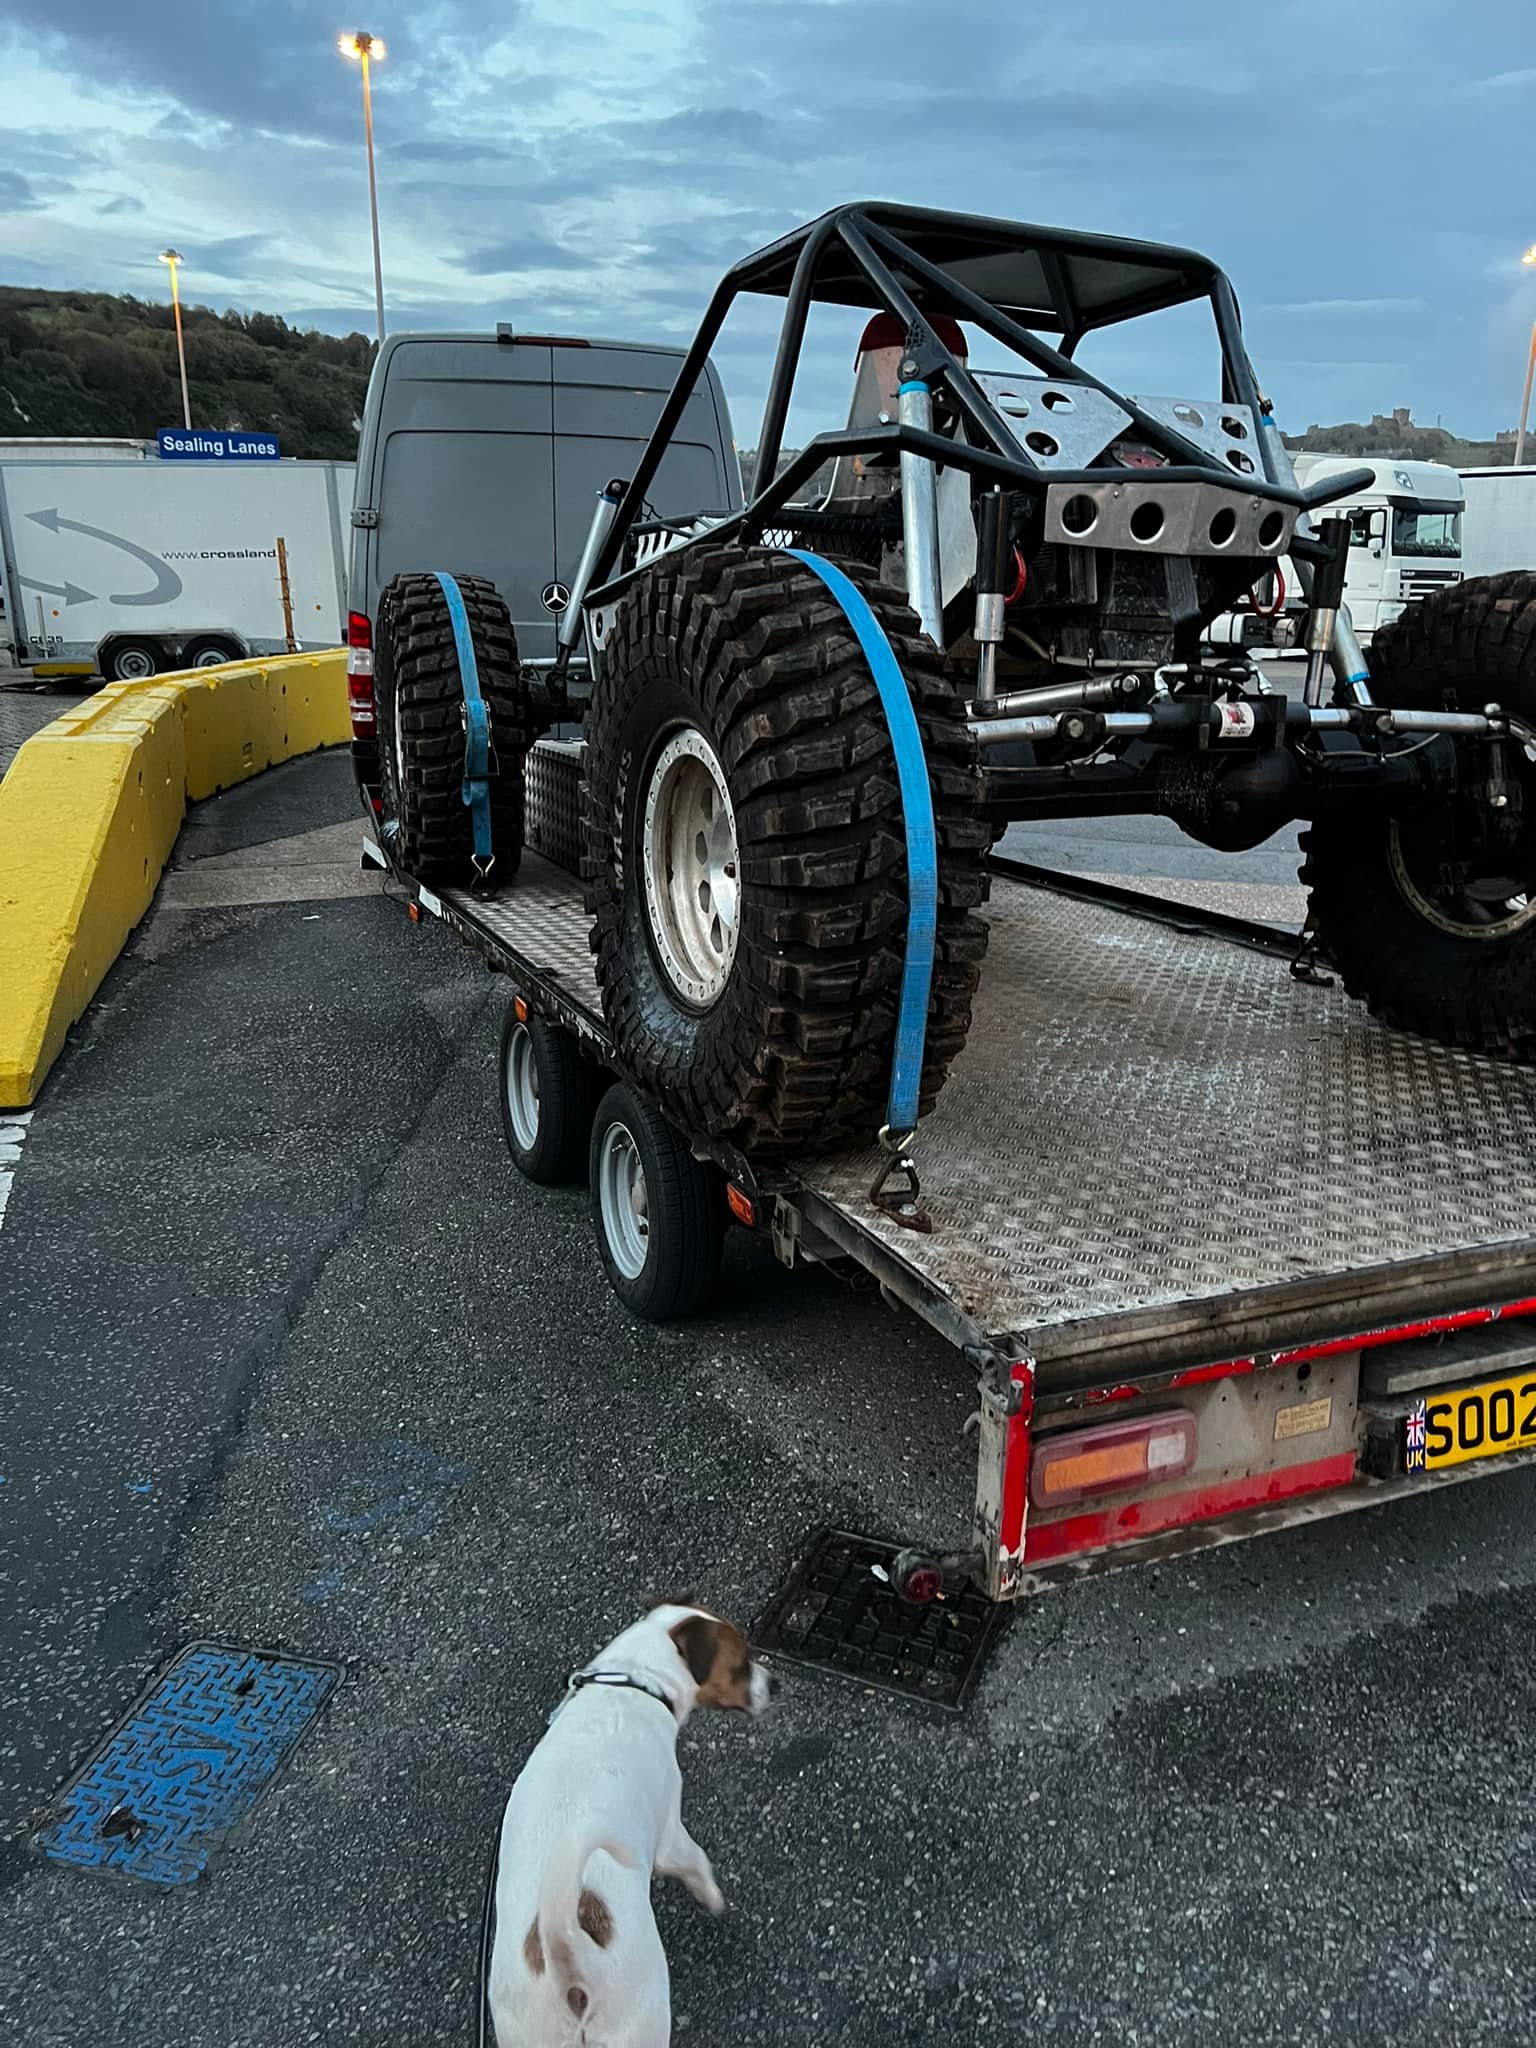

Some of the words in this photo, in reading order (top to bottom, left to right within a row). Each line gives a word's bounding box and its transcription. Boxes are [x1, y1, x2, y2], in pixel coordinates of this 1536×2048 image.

[163, 436, 224, 456] Sealing
[228, 439, 276, 455] Lanes
[161, 549, 289, 559] www.crossland
[1406, 1449, 1424, 1469] UK
